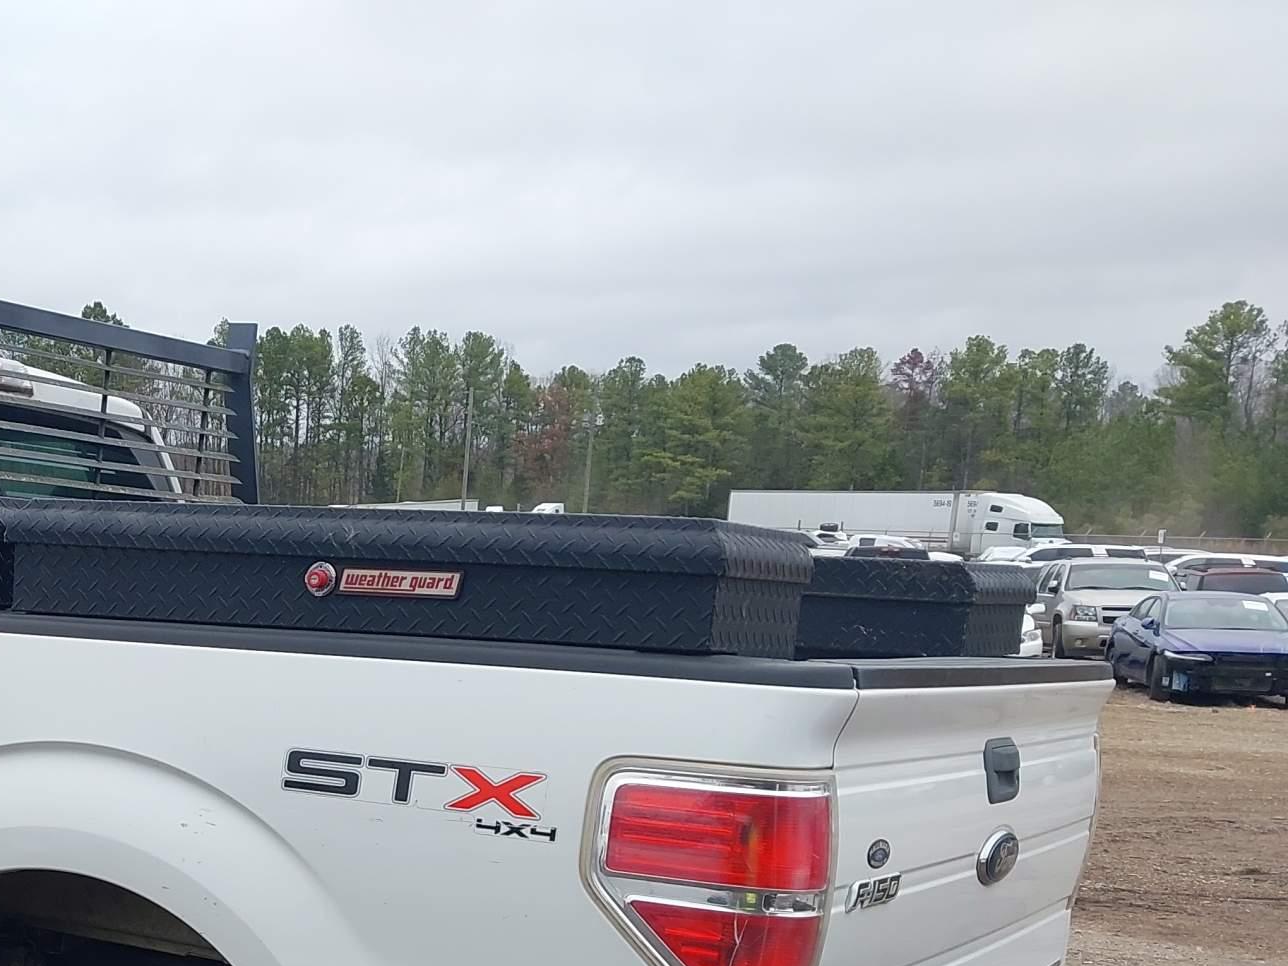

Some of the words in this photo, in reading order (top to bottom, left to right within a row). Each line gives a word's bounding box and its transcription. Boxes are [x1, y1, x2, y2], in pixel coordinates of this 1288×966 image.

[344, 572, 408, 588] weather
[409, 575, 454, 592] guard
[282, 749, 546, 819] STX
